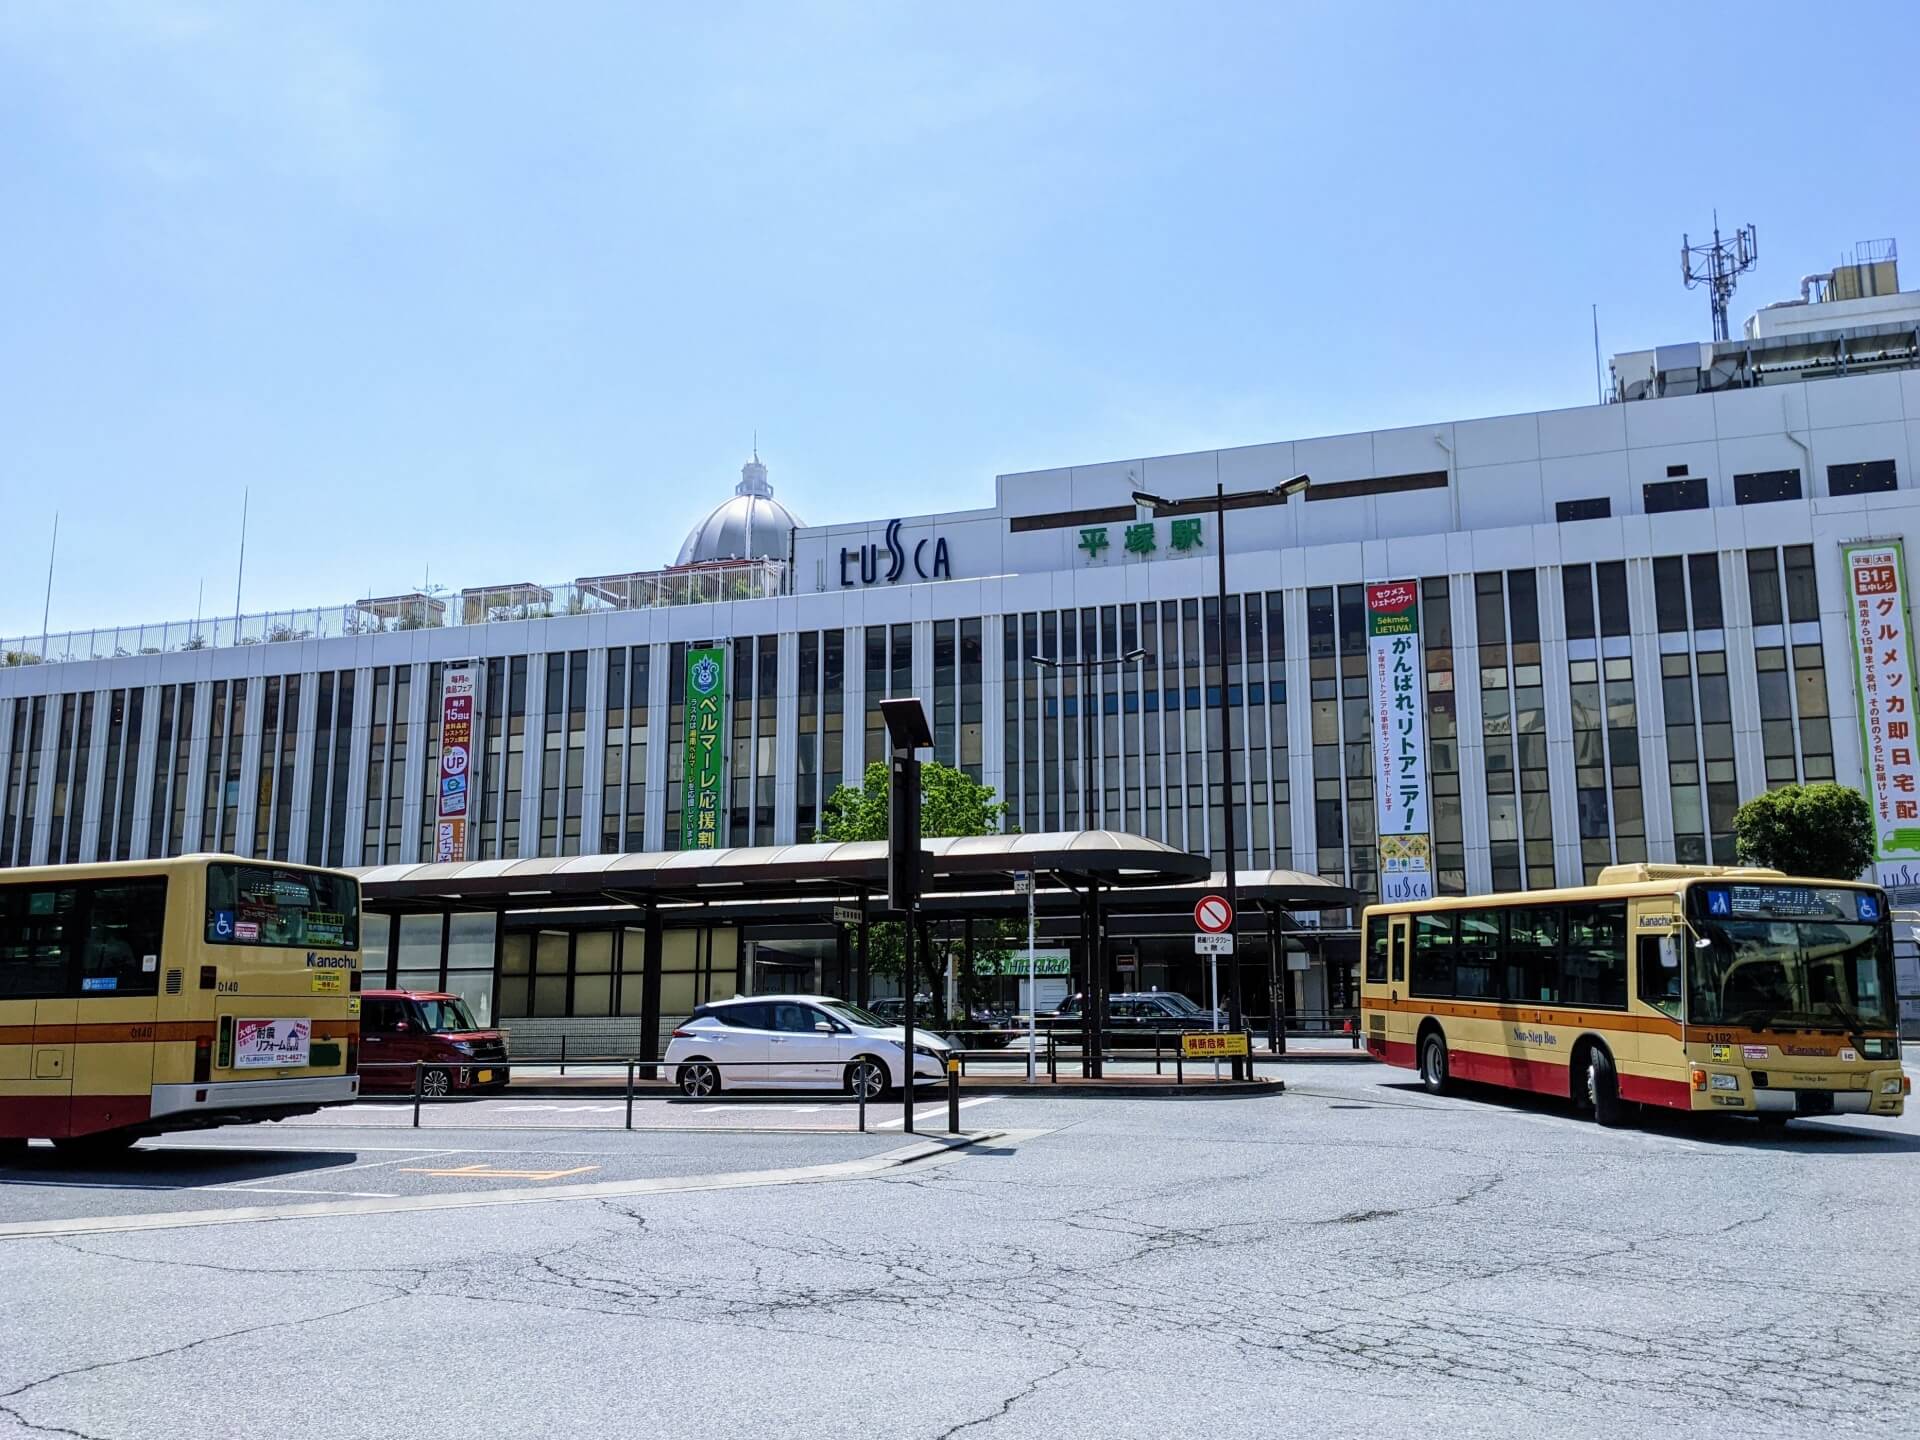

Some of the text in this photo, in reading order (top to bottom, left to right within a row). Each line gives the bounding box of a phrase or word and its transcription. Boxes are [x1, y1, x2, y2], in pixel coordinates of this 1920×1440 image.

[1078, 517, 1204, 559] 平塚駅
[841, 519, 951, 586] LUSCA
[1858, 570, 1890, 583] B1F
[1376, 587, 1405, 598] セクメス
[1375, 624, 1412, 634] LIETUVA!
[445, 708, 470, 721] 15日は
[446, 757, 465, 769] UP
[1387, 877, 1427, 898] LUSCA
[306, 951, 357, 969] Kanachu
[1513, 1026, 1557, 1046] Non-Step Bus
[255, 1039, 286, 1052] リフォーム
[1188, 1037, 1226, 1050] 横断危険
